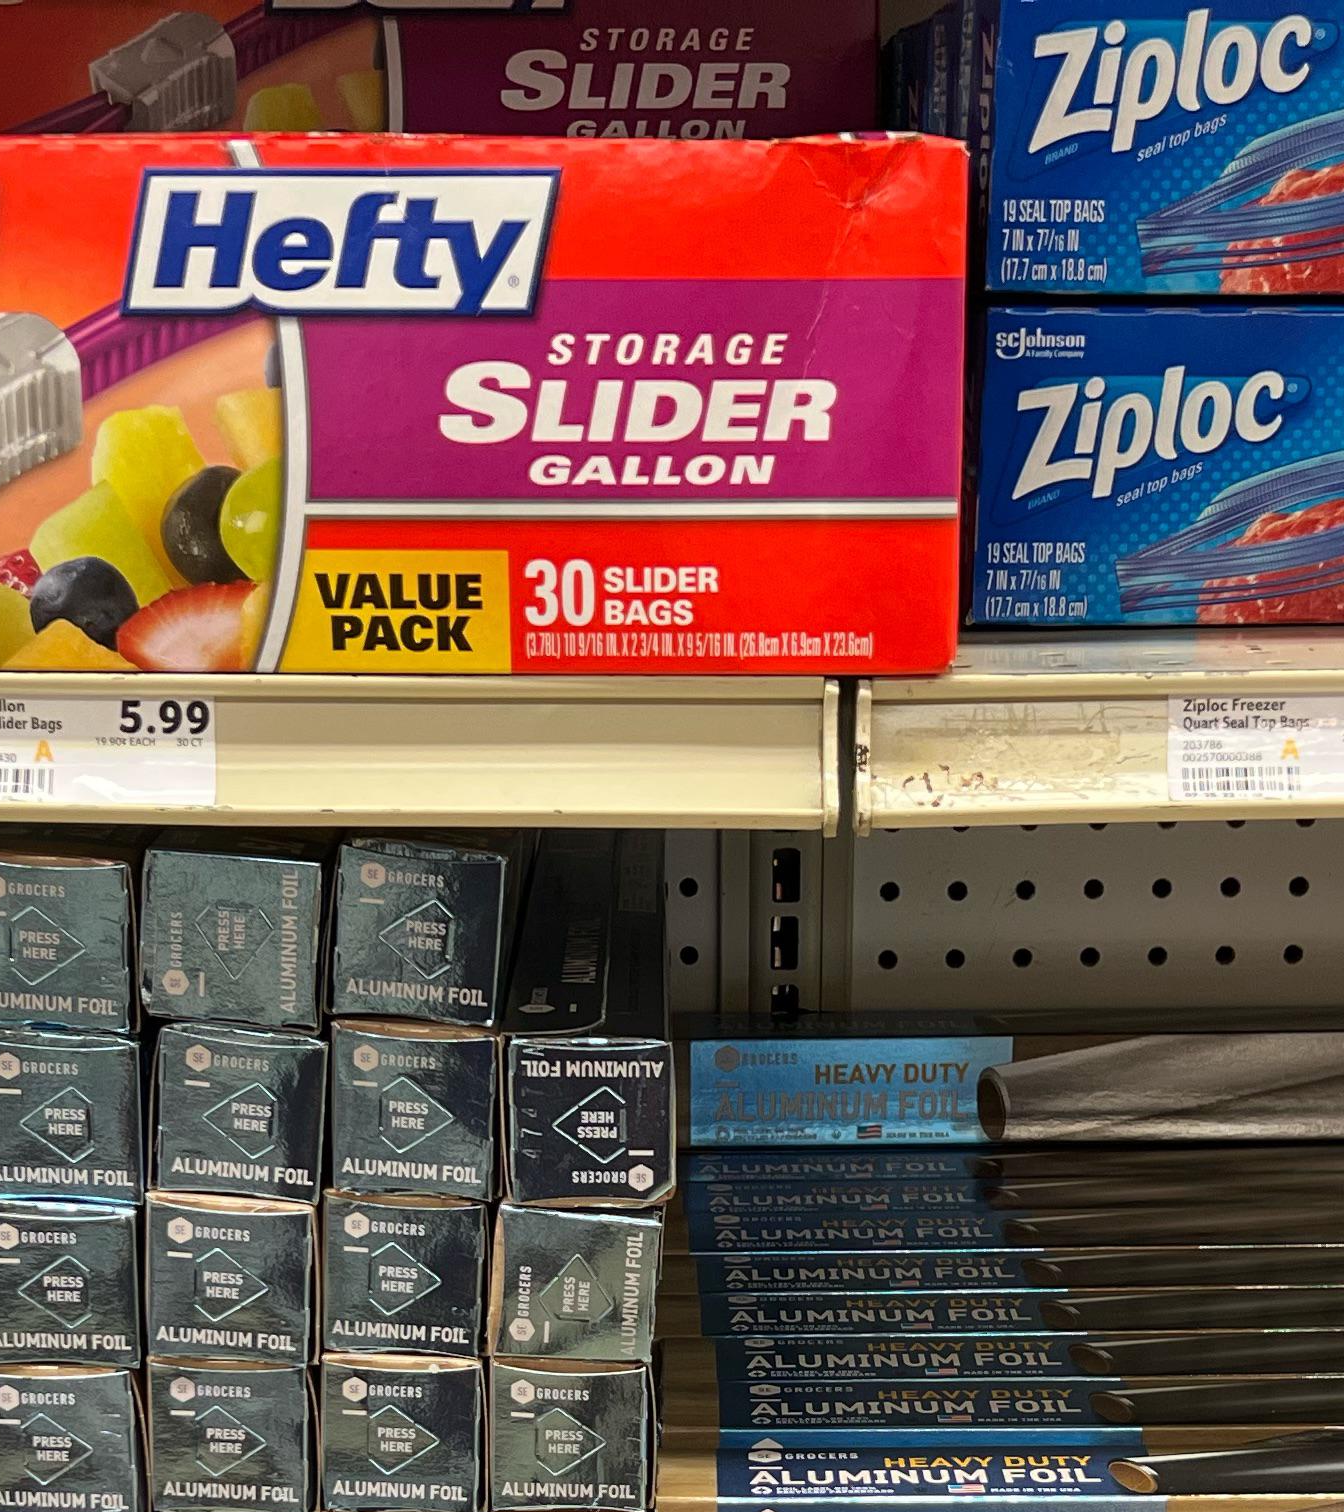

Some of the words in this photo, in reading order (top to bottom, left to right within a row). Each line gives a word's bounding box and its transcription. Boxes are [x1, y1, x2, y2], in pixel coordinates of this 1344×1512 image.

[579, 28, 754, 51] STORAGE
[501, 49, 791, 112] SLIDER
[1027, 8, 1314, 153] Ziploc
[155, 190, 531, 316] Hefty
[547, 332, 789, 366] STORAGE
[438, 360, 838, 445] SLIDER
[1012, 365, 1285, 500] Ziploc
[528, 455, 776, 487] GALLON
[314, 573, 483, 610] VALUE
[524, 558, 596, 627] 30
[331, 614, 473, 652] PACK
[119, 699, 210, 735] 5.99
[1183, 699, 1229, 715] Ziploc
[1231, 698, 1286, 712] Freezer
[31, 717, 63, 732] Bags
[7, 882, 66, 899] GROCERS
[19, 929, 61, 946] PRESS
[22, 946, 58, 961] HERE
[77, 997, 119, 1017] FOIL
[522, 1060, 561, 1078] FOIL
[568, 1060, 664, 1078] ALUMINUM
[814, 1063, 896, 1085] HEAVY
[903, 1062, 970, 1085] DUTY
